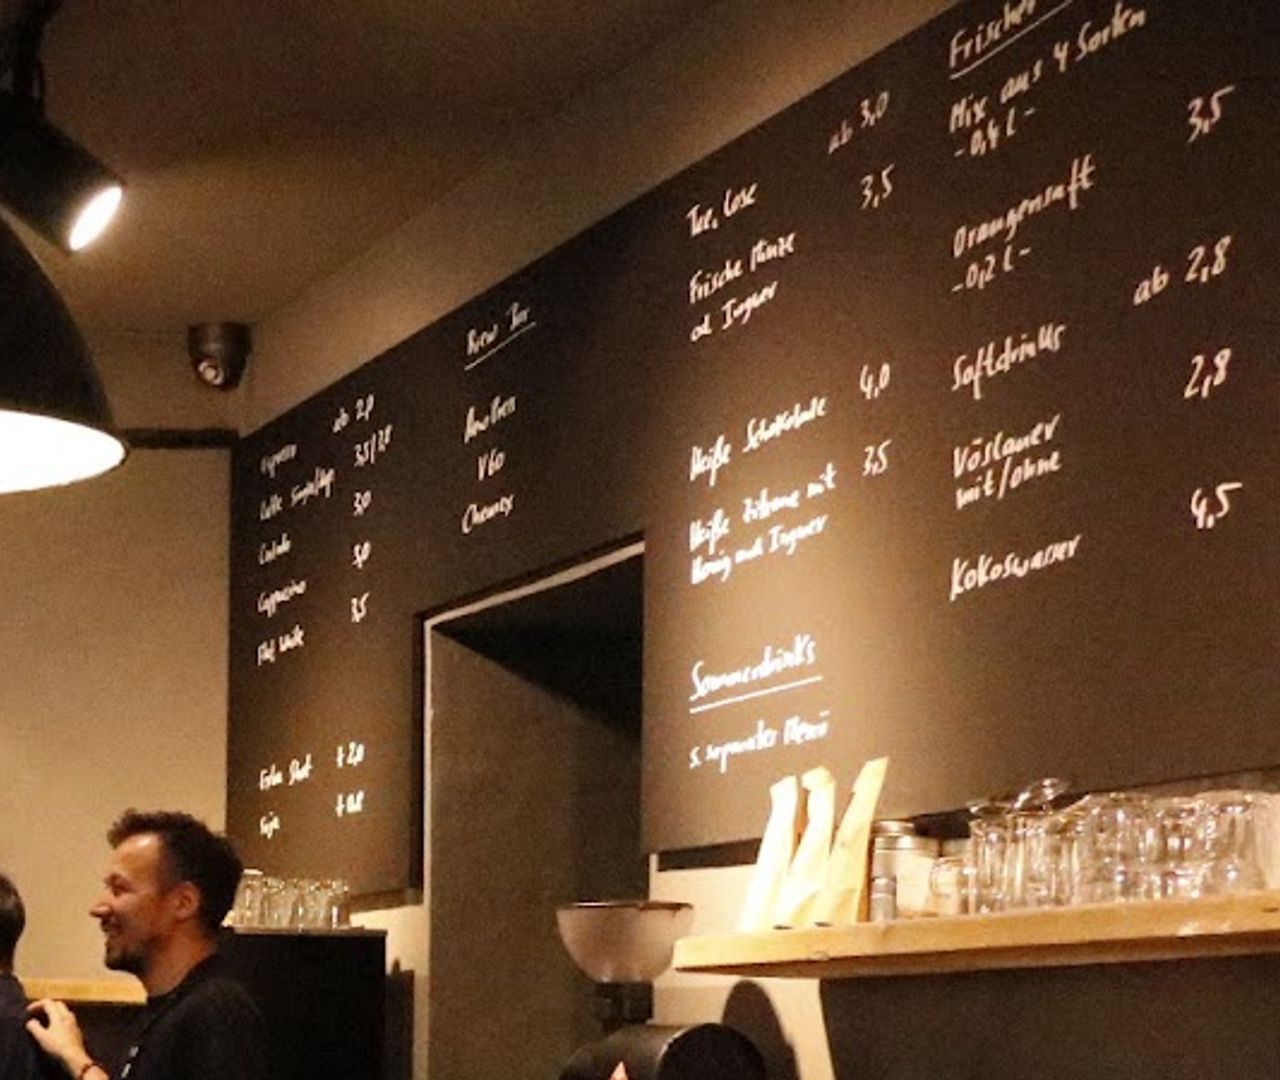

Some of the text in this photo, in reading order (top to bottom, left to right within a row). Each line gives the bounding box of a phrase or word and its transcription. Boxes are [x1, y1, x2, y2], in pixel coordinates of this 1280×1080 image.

[950, 2, 1146, 133] Mix aus 4 Sorten
[828, 119, 853, 155] ab
[953, 85, 1235, 258] Orangensaft 3,5
[690, 260, 743, 303] Frische
[860, 163, 895, 209] 3,5
[952, 236, 1231, 400] Softdrinks ab 2,8
[1184, 348, 1231, 399] 2,8
[860, 362, 890, 399] 4,0
[863, 439, 892, 476] 3,5
[949, 482, 1243, 601] Kokoswasser 4,5
